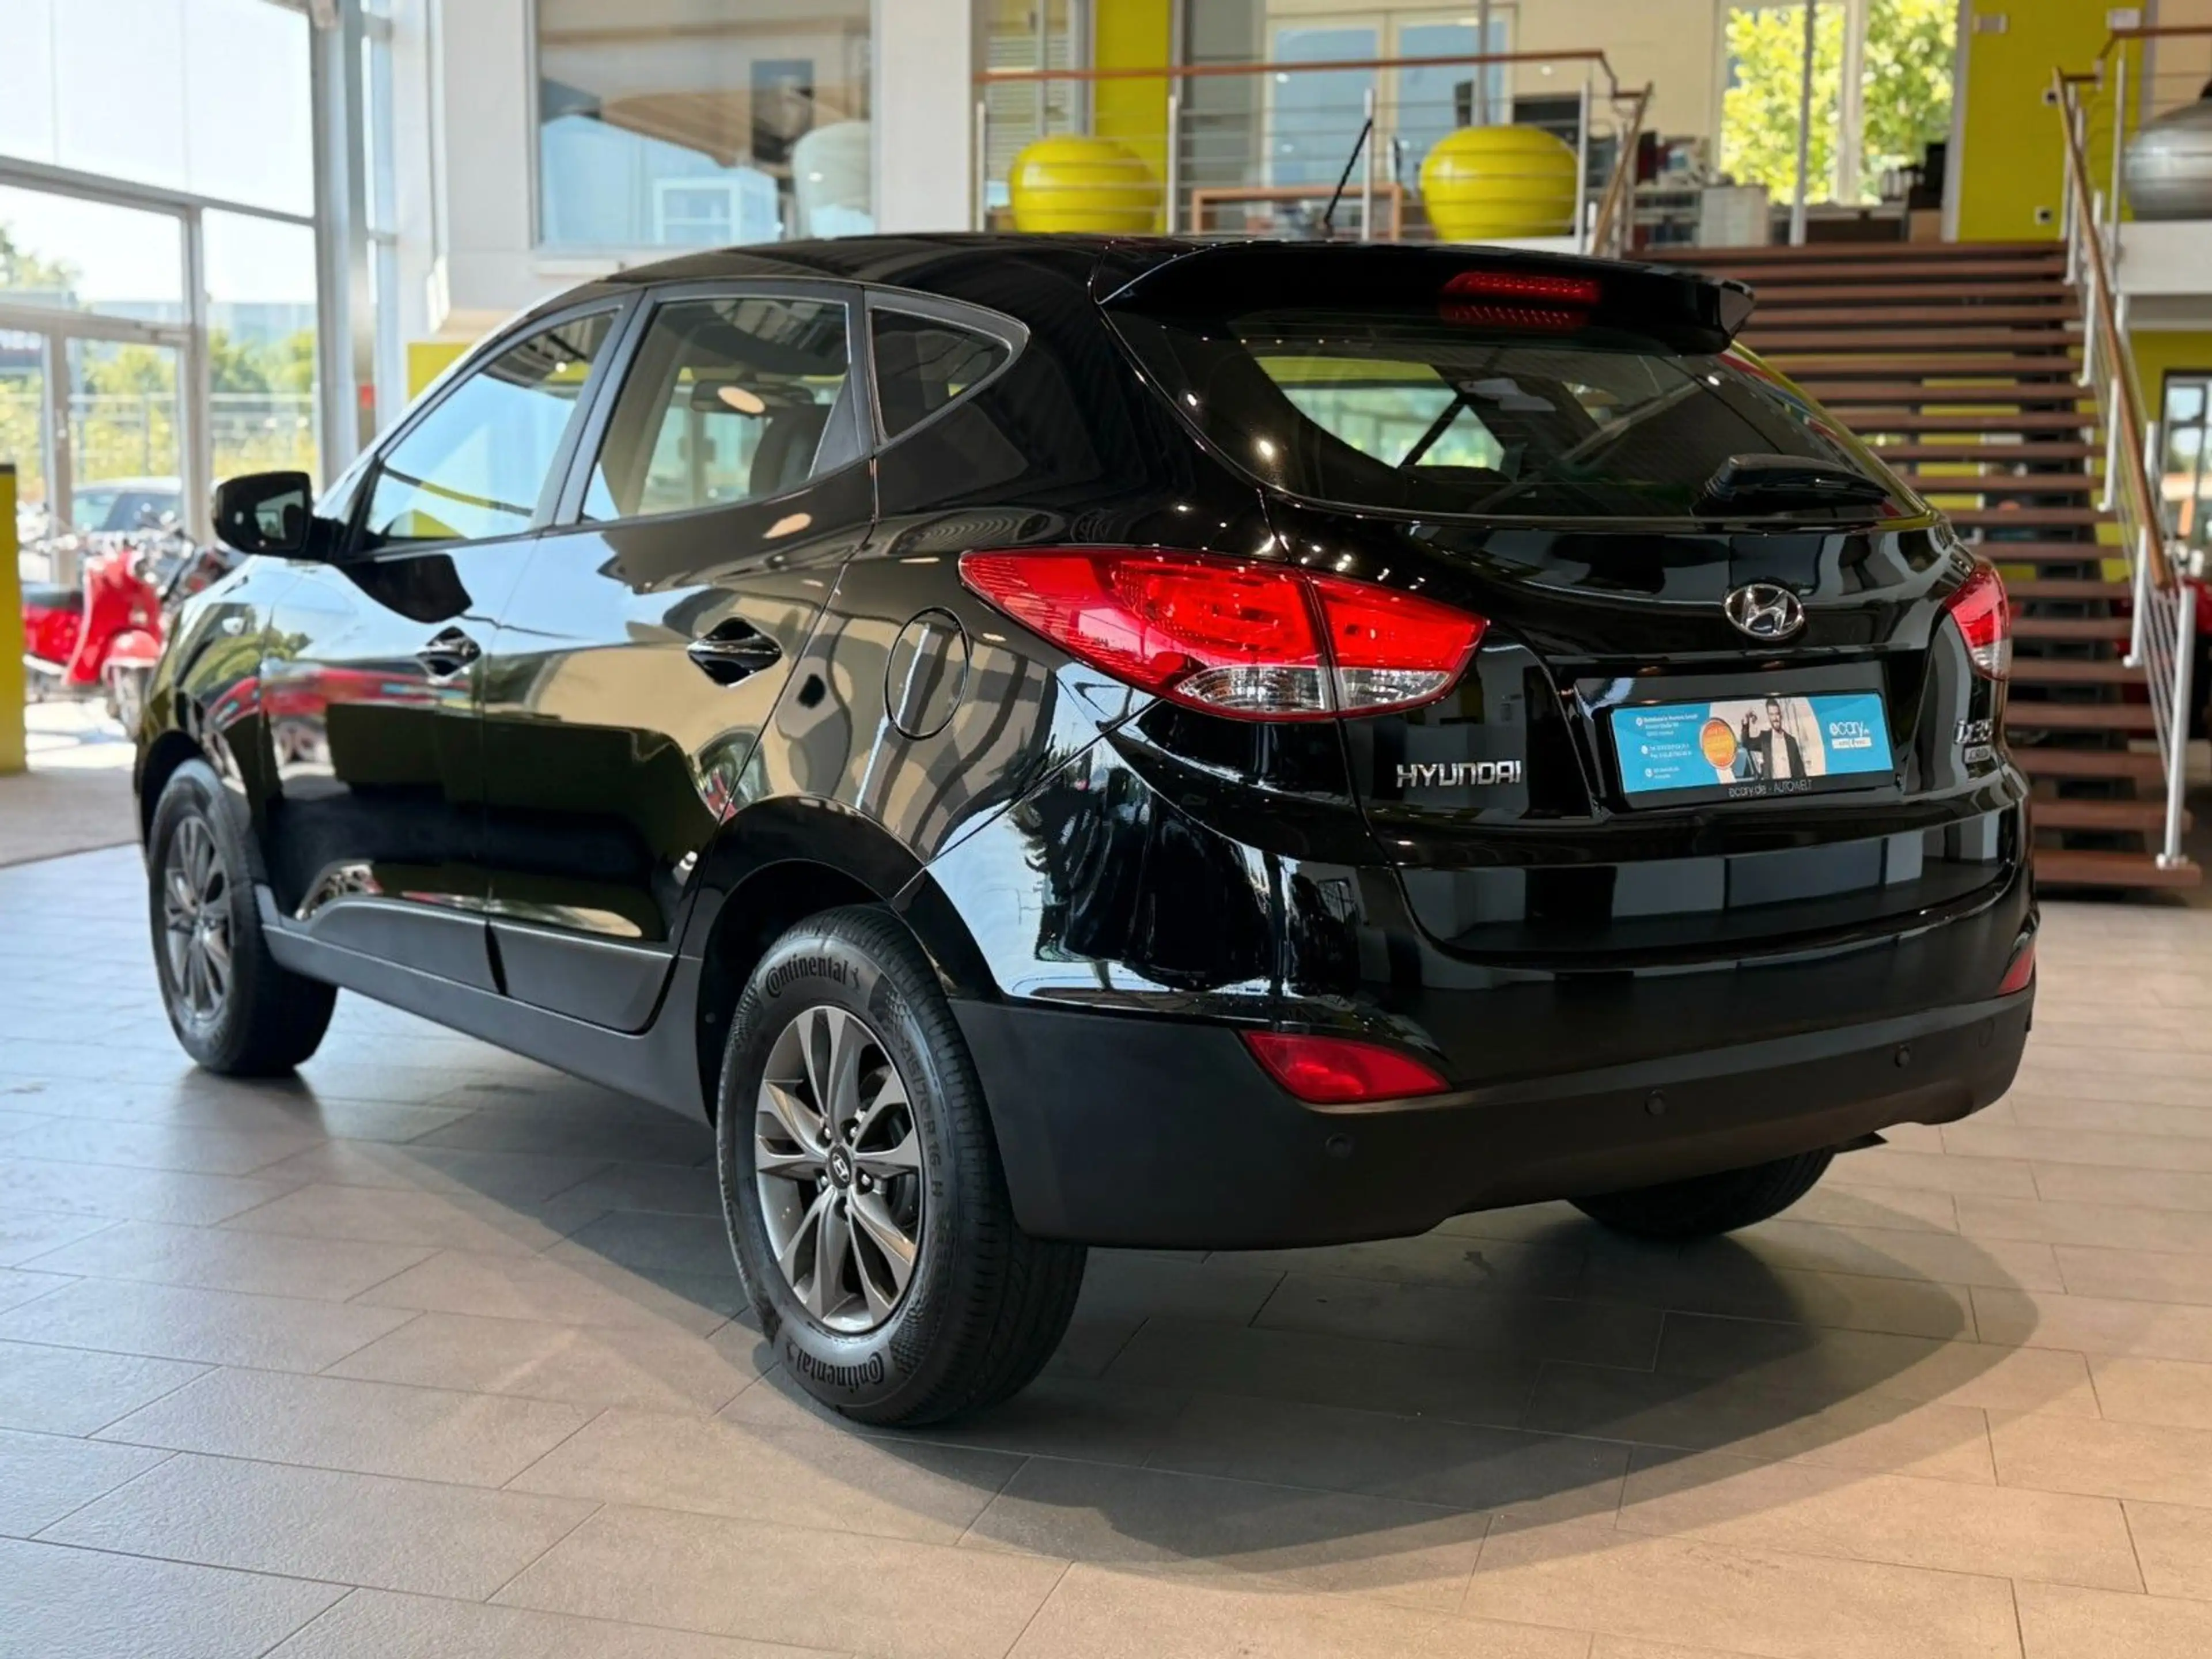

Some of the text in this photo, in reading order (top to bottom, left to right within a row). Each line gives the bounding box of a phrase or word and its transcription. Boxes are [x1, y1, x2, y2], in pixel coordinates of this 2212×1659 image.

[1396, 760, 1522, 787] HYUNDAI
[765, 953, 849, 998] Continental
[796, 1345, 885, 1394] Continental
